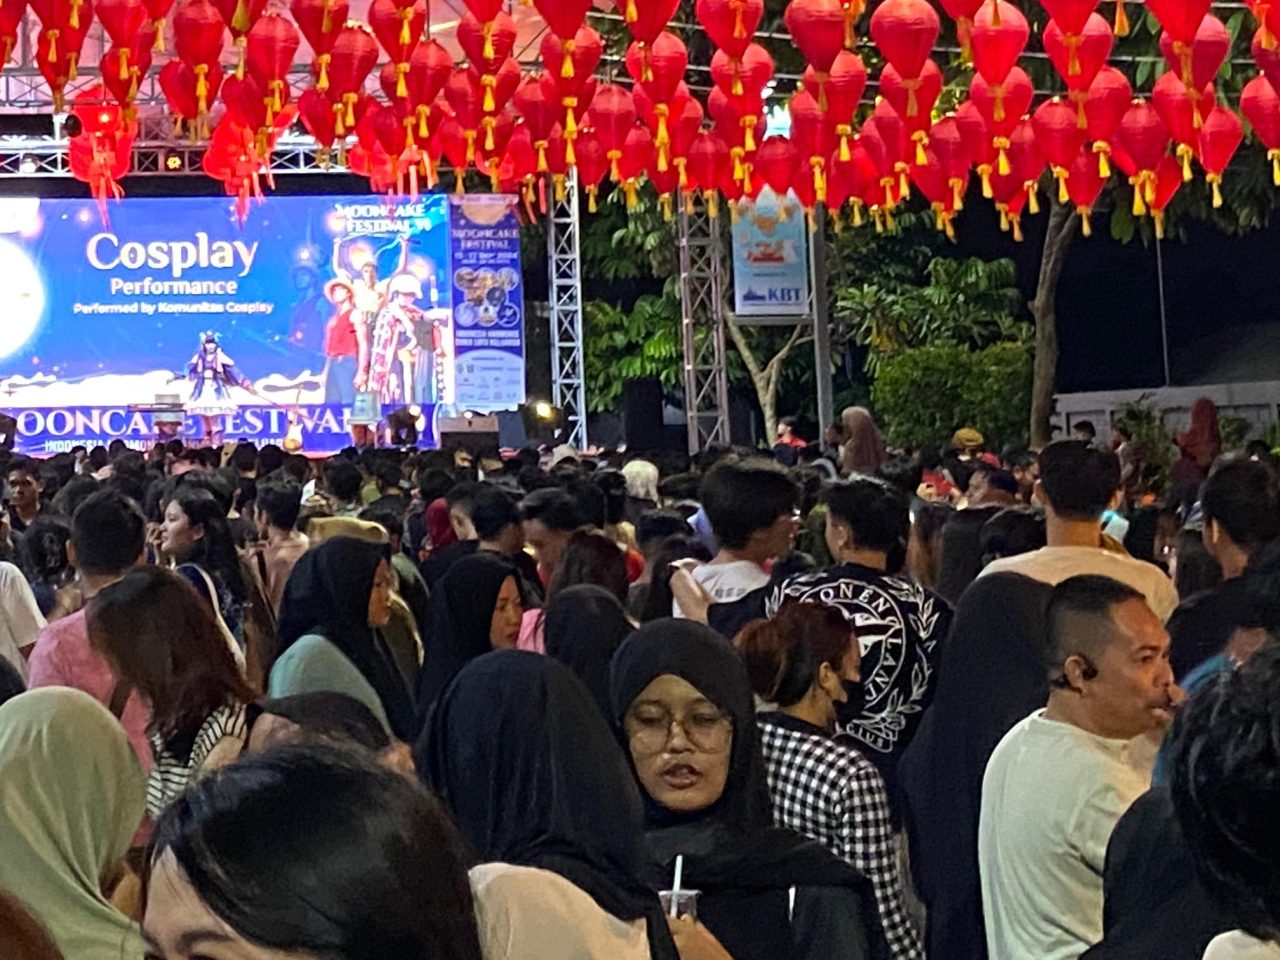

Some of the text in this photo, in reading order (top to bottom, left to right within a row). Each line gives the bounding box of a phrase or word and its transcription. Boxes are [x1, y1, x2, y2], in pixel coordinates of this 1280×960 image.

[87, 232, 259, 277] Cosplay
[111, 277, 238, 295] Performance
[768, 288, 802, 301] KBT
[74, 303, 138, 315] Performed
[141, 302, 155, 315] by
[226, 302, 274, 314] Cosplay
